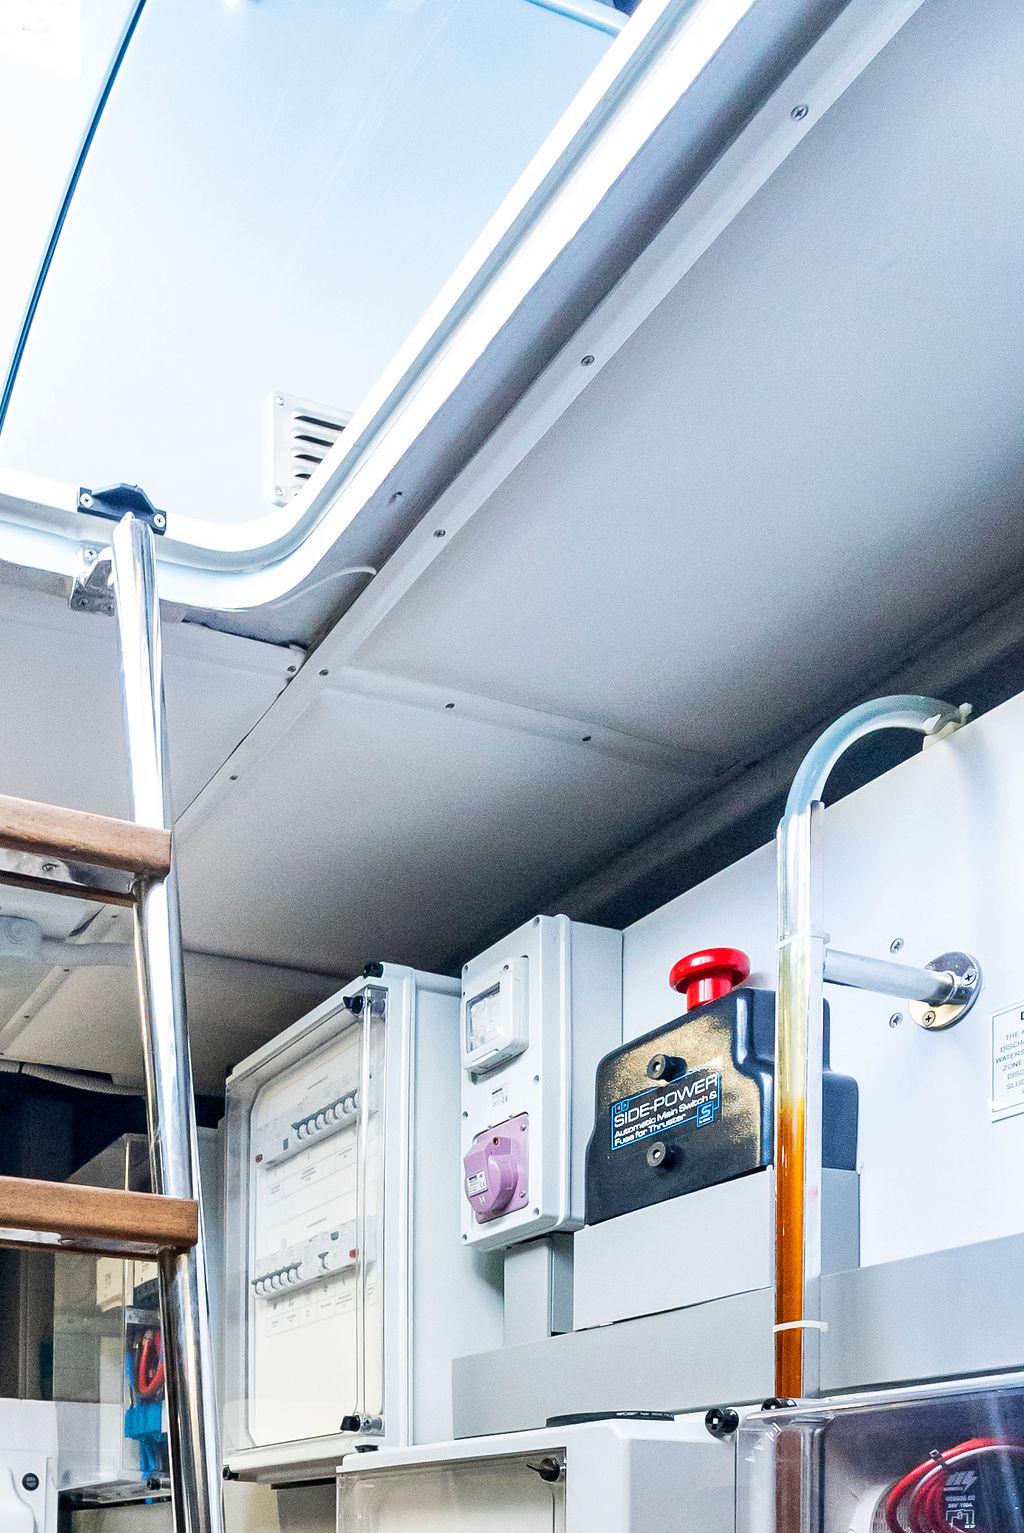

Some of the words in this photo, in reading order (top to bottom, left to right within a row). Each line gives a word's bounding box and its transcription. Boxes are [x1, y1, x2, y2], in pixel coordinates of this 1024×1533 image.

[1000, 1040, 1024, 1053] DISCH
[614, 1073, 717, 1128] SIDE-POWER
[614, 1117, 656, 1139] Automatic
[656, 1108, 678, 1122] Main
[678, 1094, 709, 1113] Switch
[709, 1090, 717, 1100] &
[614, 1133, 635, 1147] Fuse
[635, 1128, 648, 1140] for
[648, 1113, 687, 1133] Thruster
